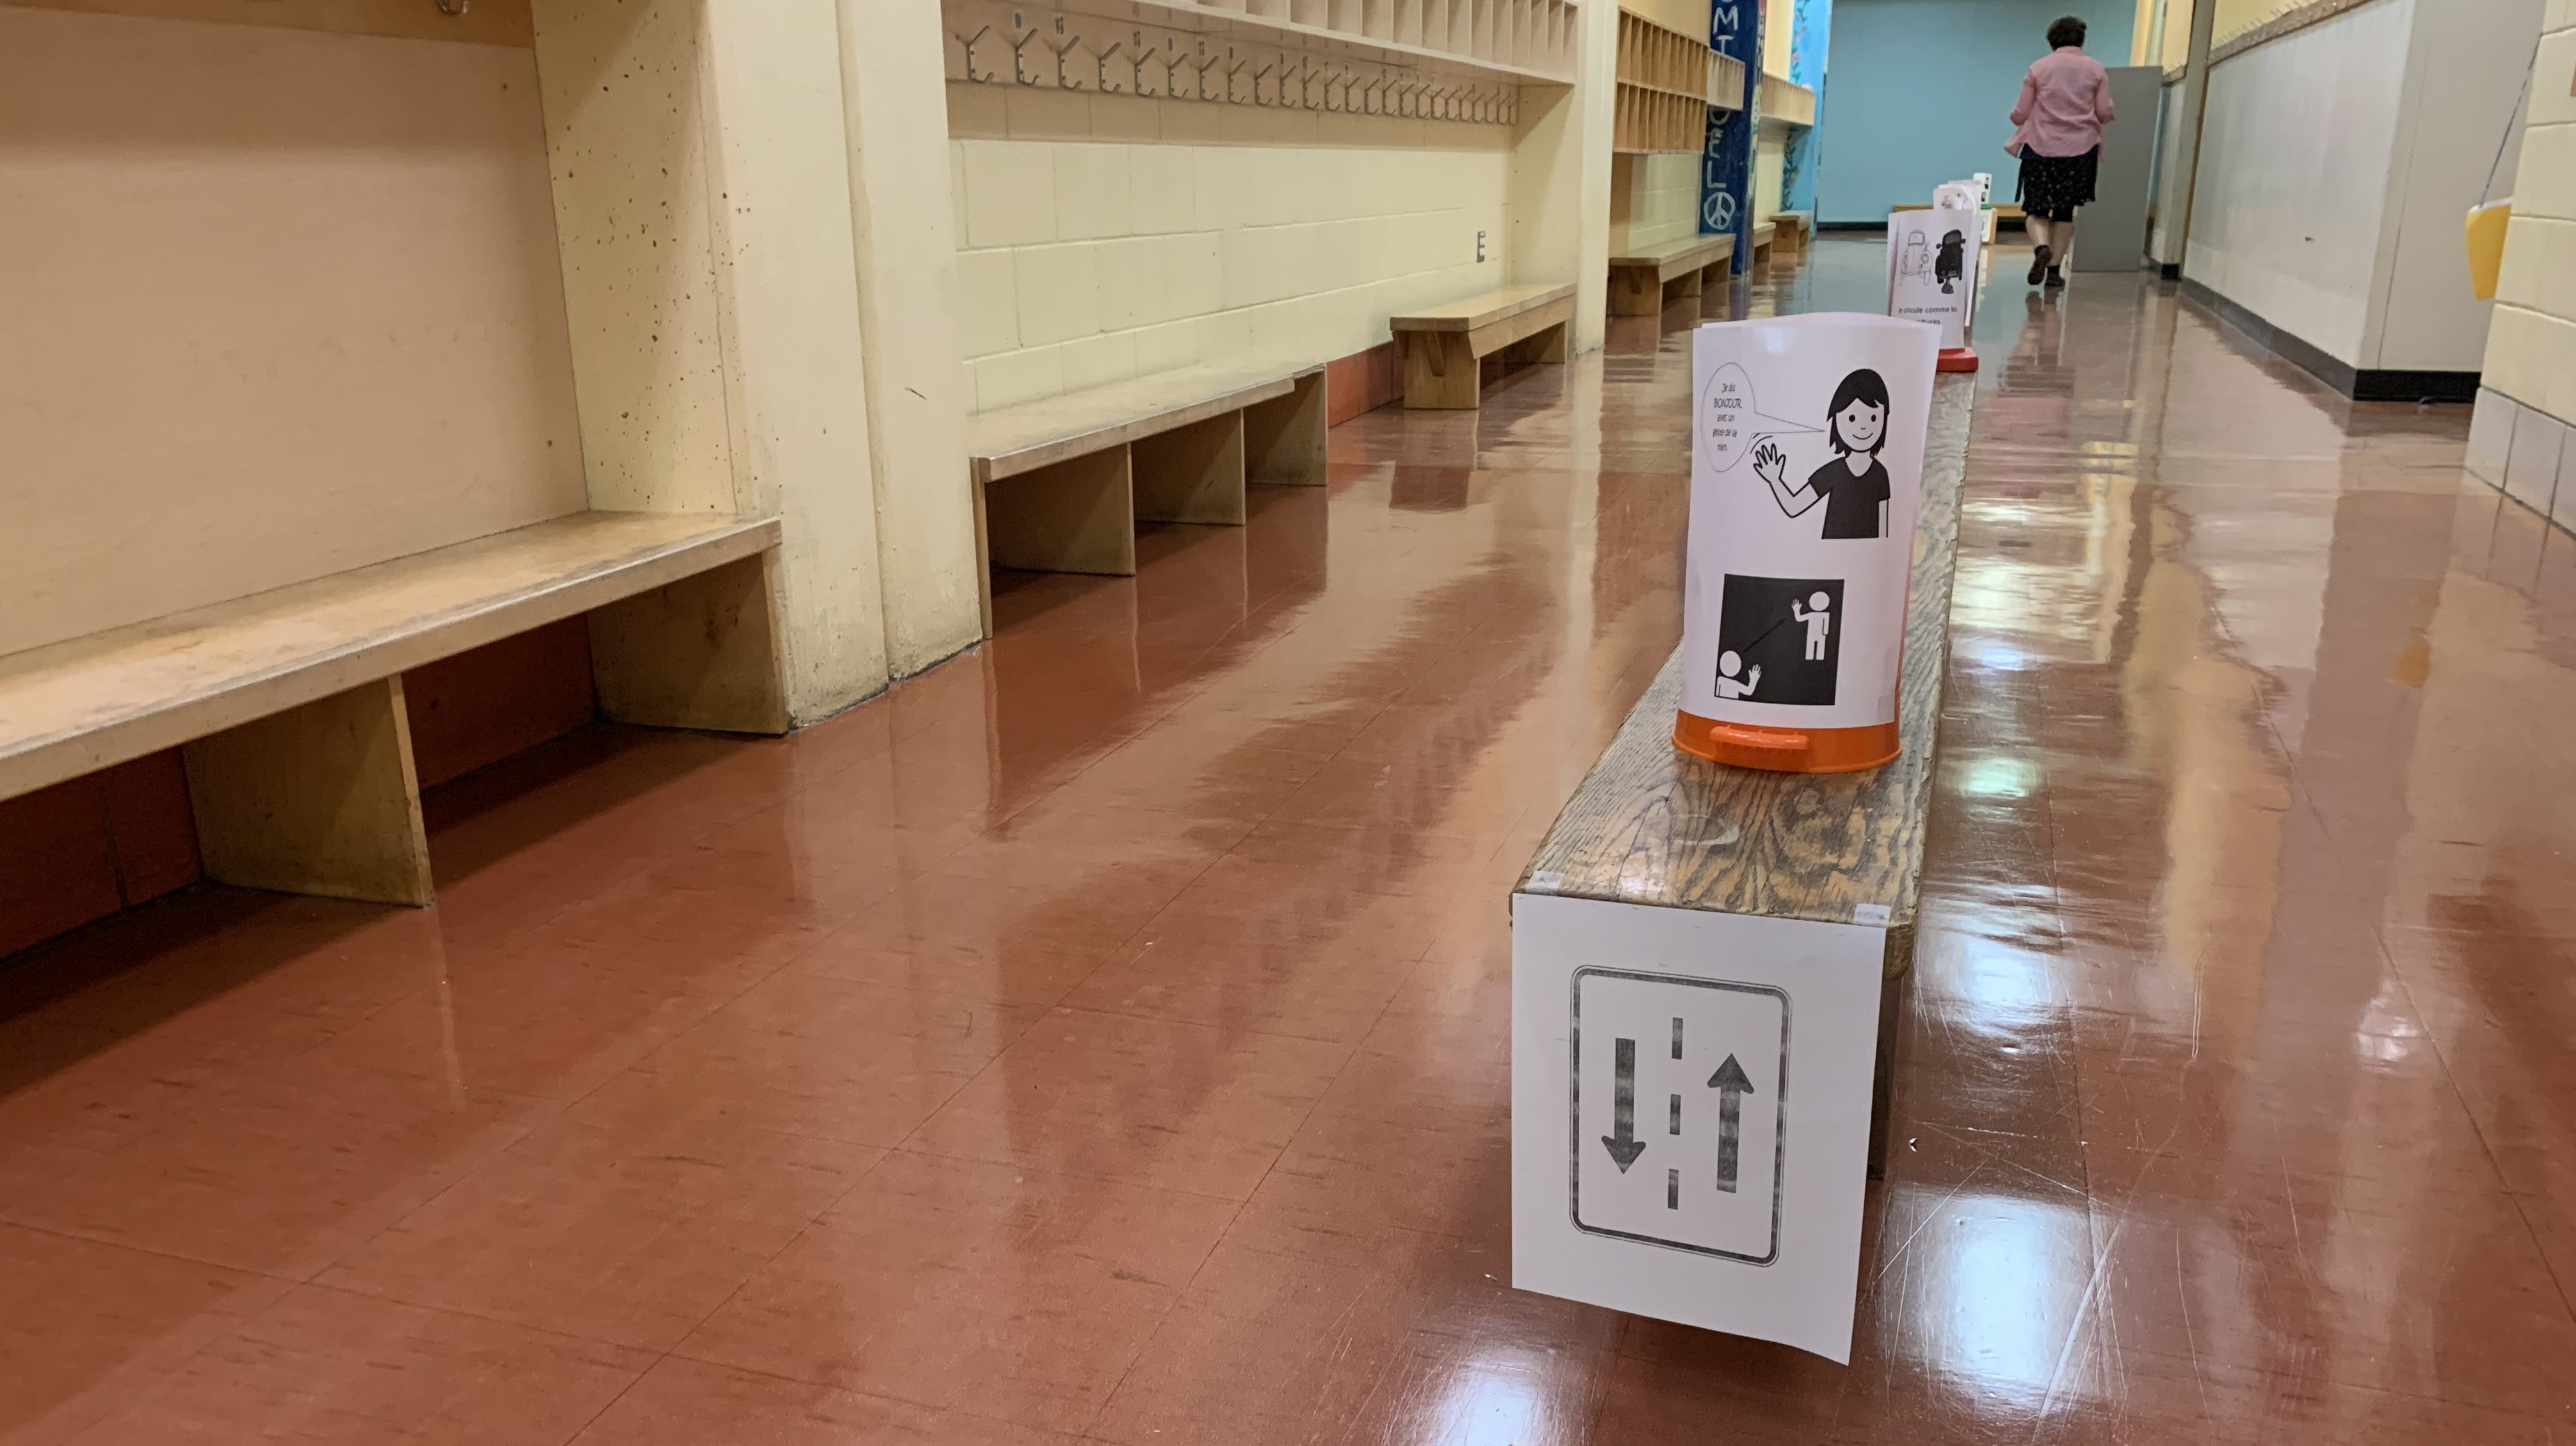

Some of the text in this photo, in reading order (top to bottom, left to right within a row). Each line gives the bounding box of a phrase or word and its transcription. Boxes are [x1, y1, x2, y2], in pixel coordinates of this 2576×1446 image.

[1722, 383, 1728, 393] Je
[1714, 397, 1742, 409] BONJOUR
[1717, 414, 1735, 422] avec un
[1712, 427, 1737, 438] geste de la
